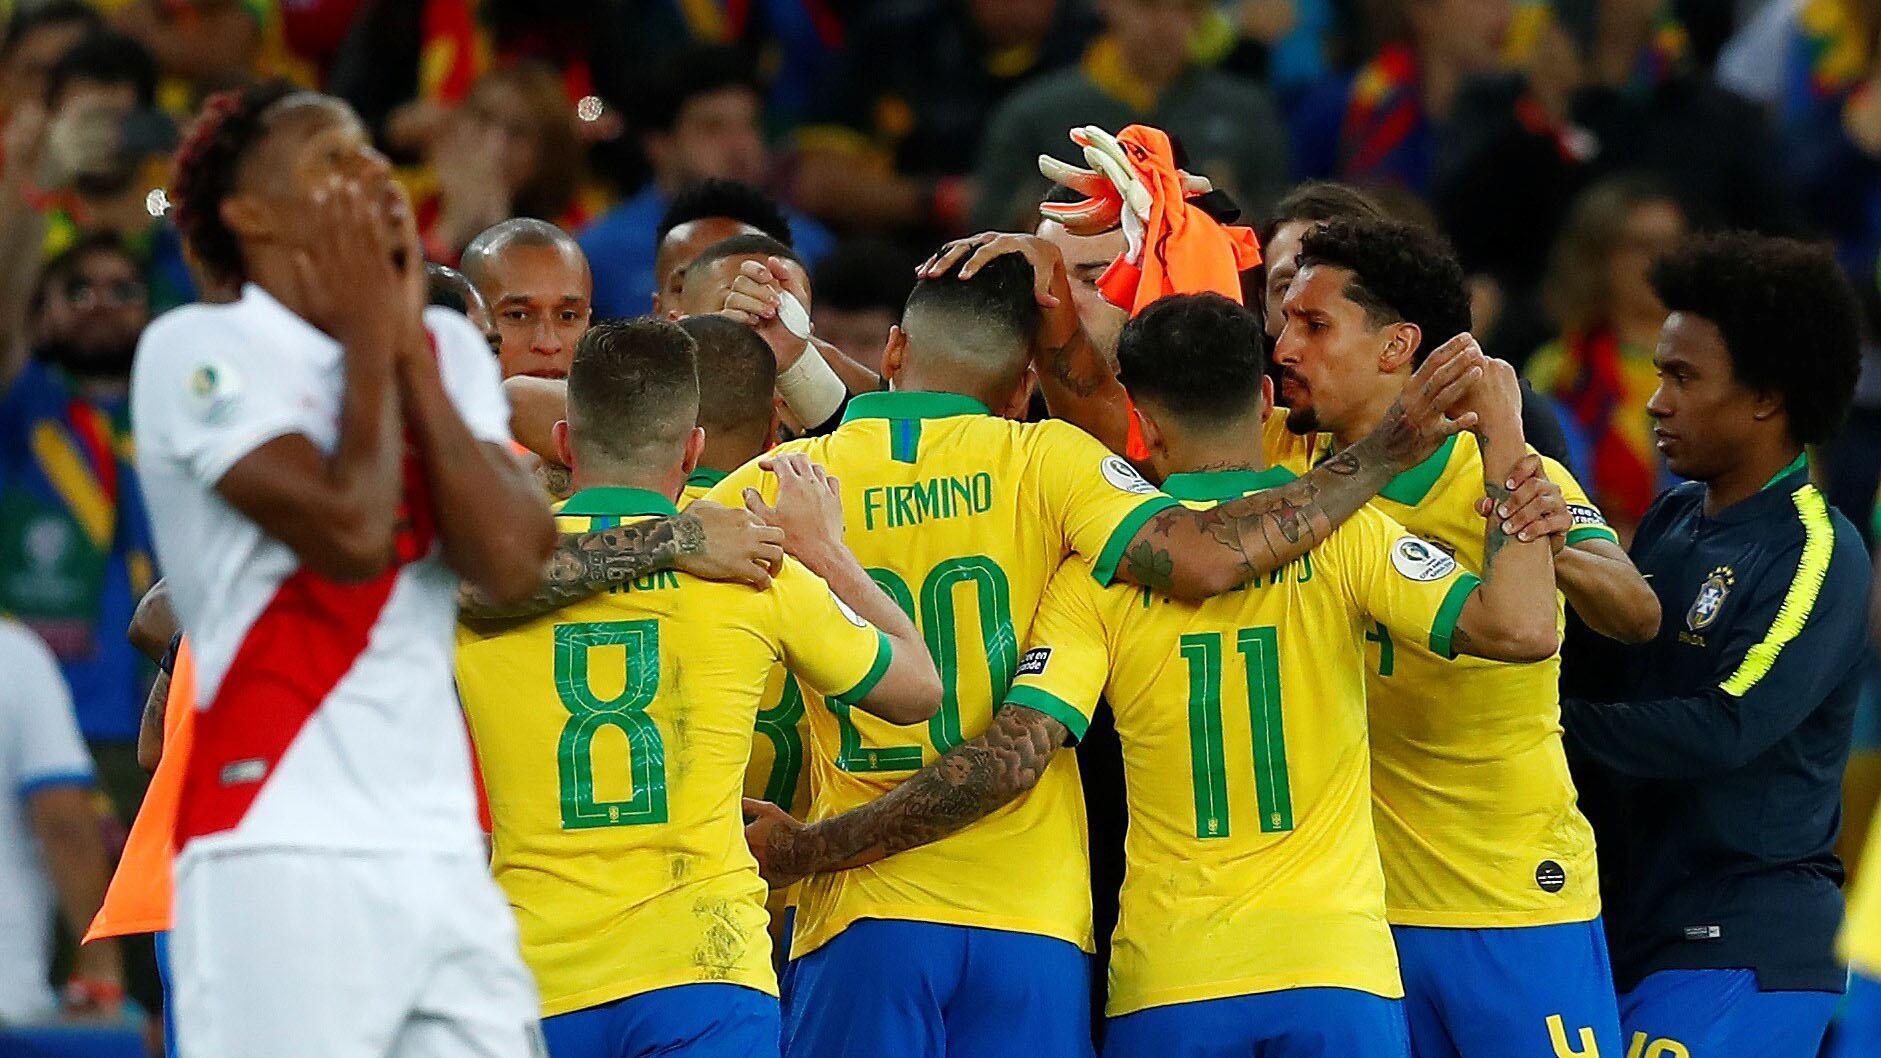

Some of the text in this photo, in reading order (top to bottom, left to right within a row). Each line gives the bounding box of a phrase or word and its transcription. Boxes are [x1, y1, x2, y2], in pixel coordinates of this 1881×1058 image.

[864, 471, 992, 531] FIRMINO
[554, 619, 669, 829] 8
[836, 554, 1018, 773] 20
[1180, 626, 1294, 839] 11
